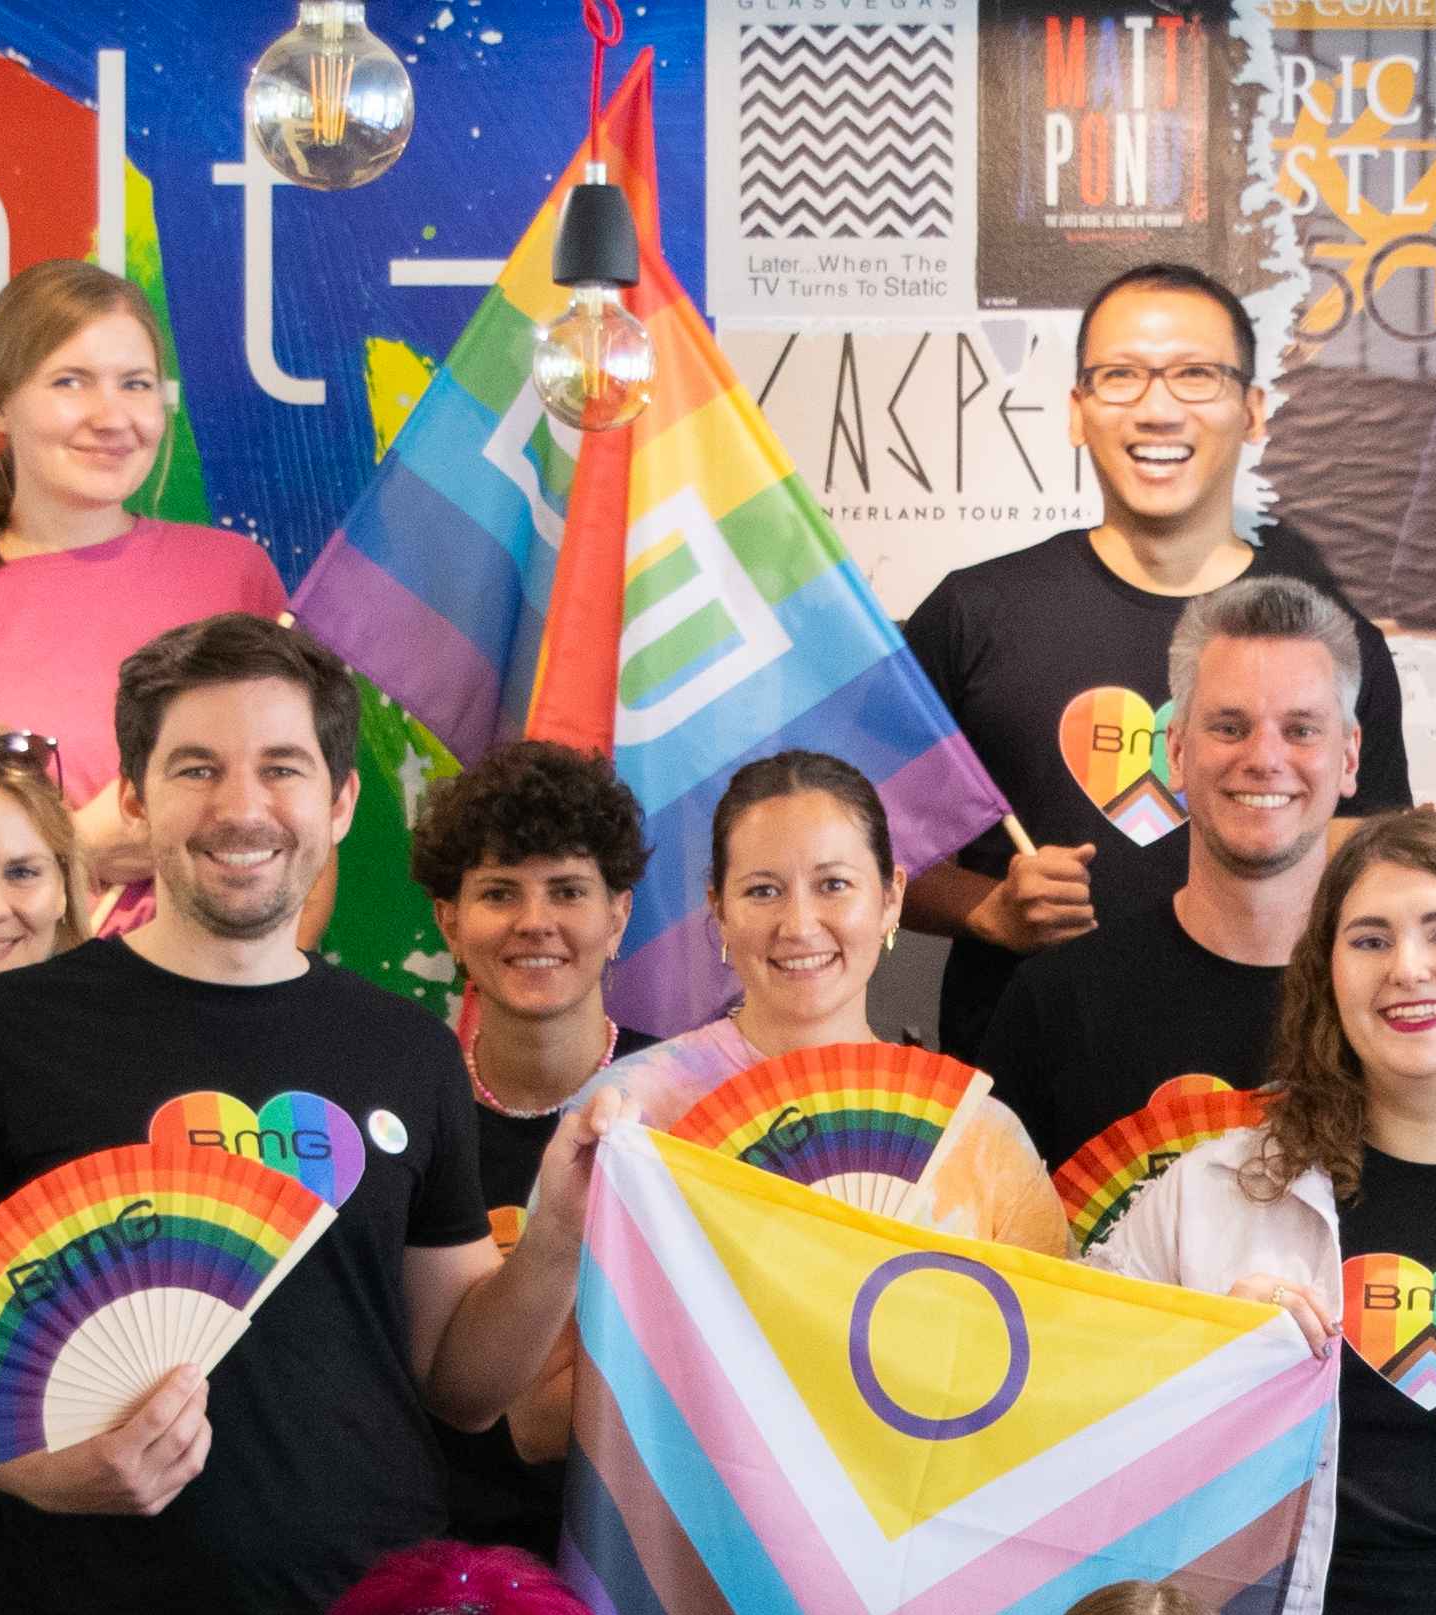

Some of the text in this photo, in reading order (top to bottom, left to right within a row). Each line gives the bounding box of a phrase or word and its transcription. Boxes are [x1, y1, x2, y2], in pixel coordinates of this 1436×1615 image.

[901, 254, 948, 273] The
[748, 276, 948, 298] TV Turns To Static
[958, 506, 1020, 521] TOUR
[1090, 724, 1169, 756] BM
[6, 1198, 162, 1312] BMG
